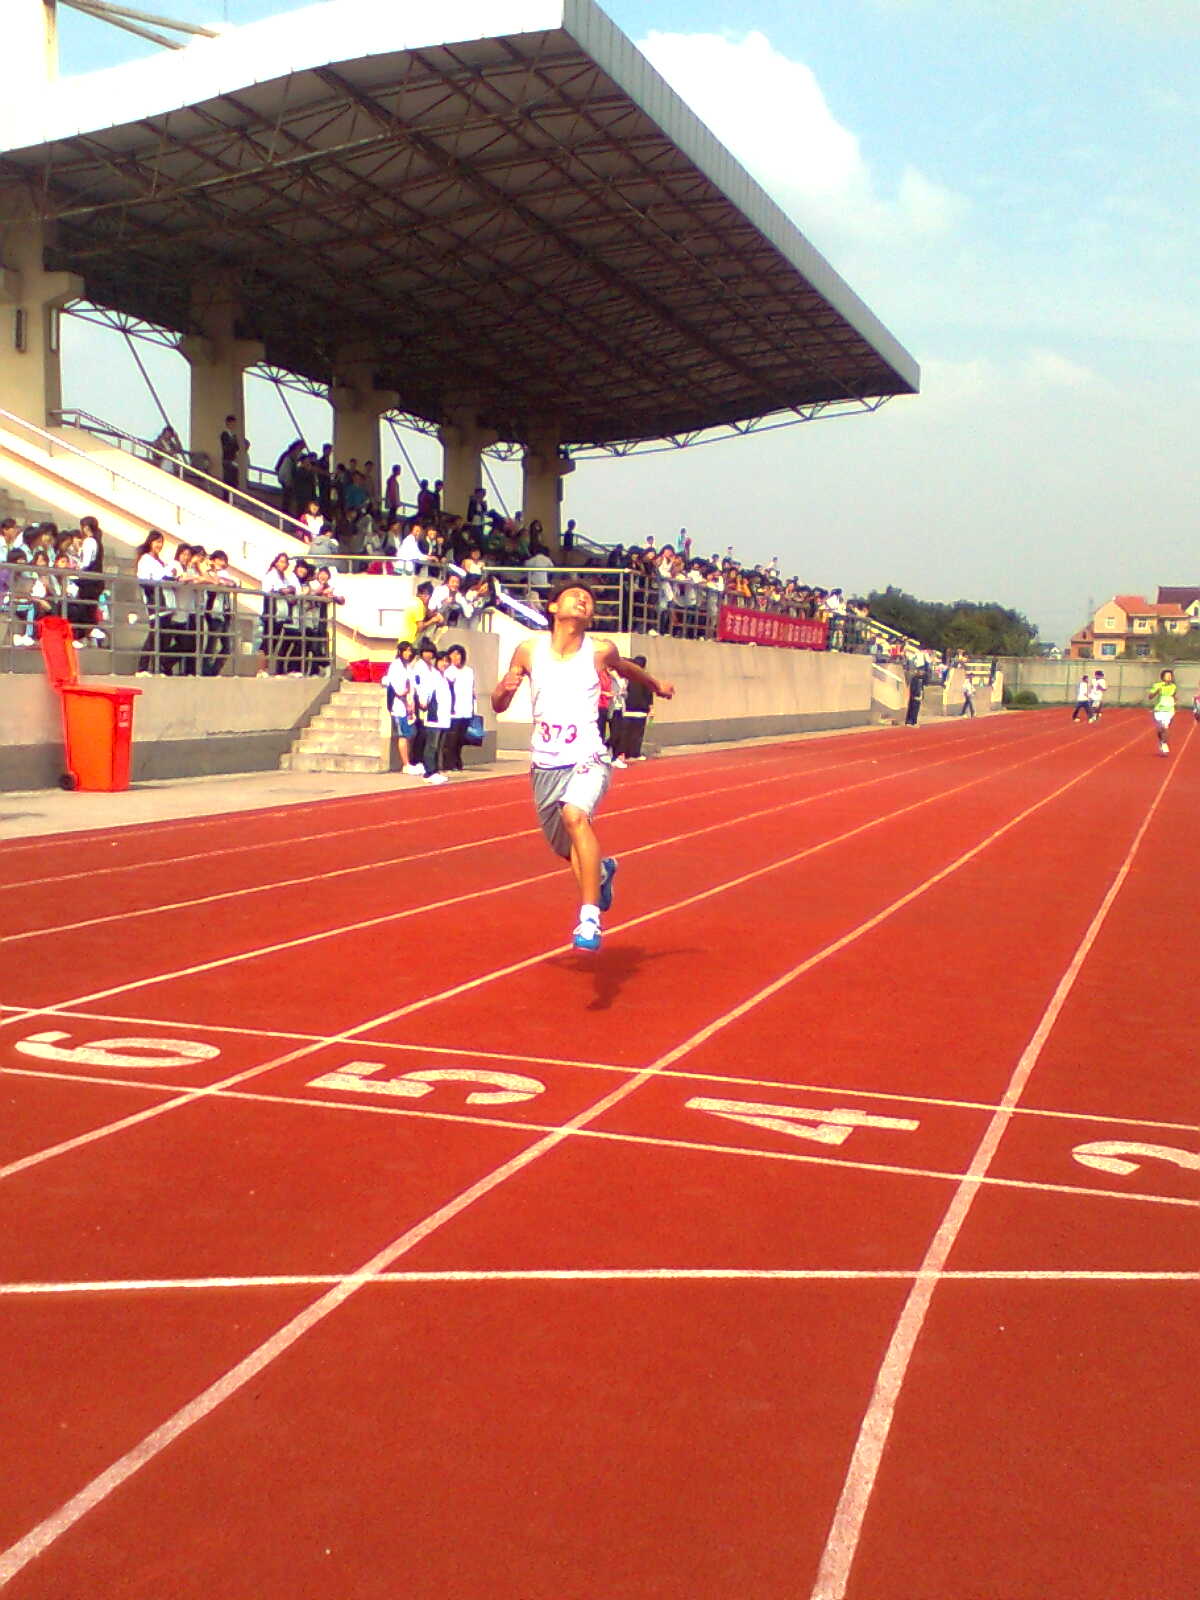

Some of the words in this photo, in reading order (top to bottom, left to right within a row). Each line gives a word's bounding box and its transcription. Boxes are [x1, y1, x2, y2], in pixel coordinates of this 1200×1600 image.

[540, 721, 578, 744] 373
[15, 1031, 220, 1068] 6
[306, 1062, 545, 1104] 5
[685, 1097, 919, 1145] 4
